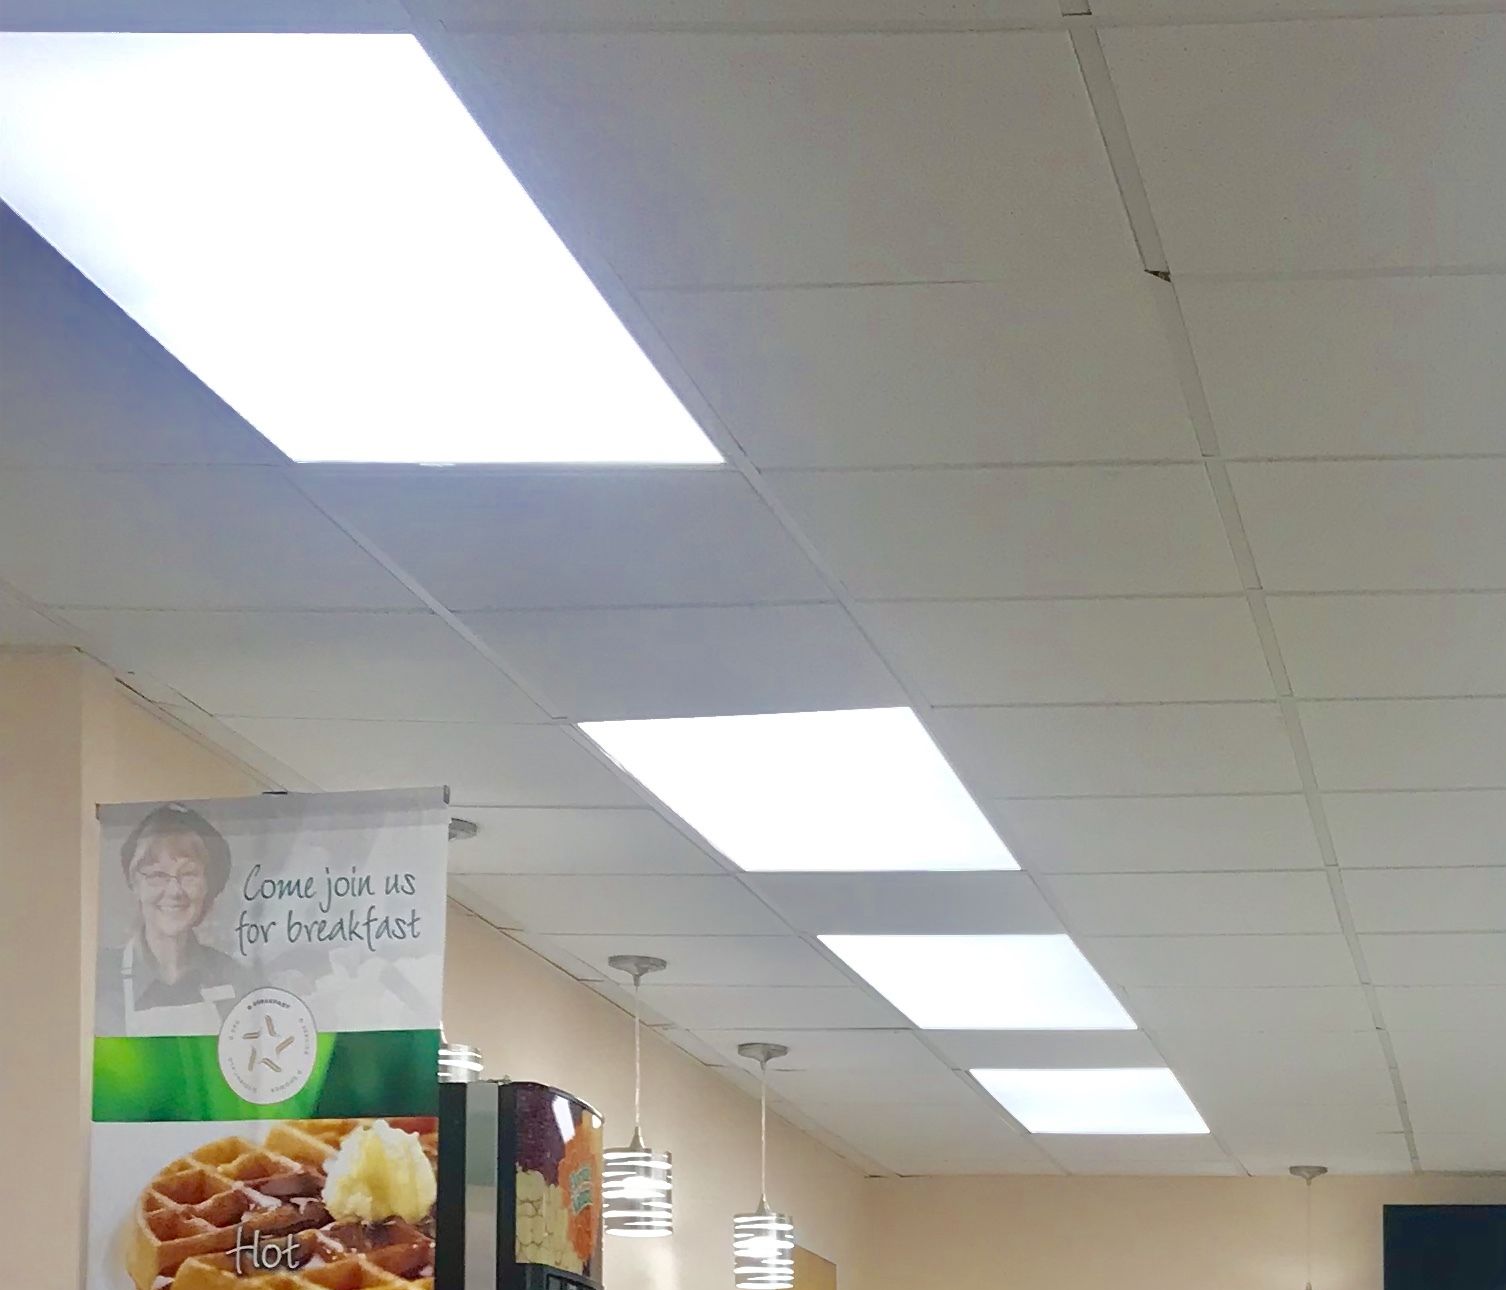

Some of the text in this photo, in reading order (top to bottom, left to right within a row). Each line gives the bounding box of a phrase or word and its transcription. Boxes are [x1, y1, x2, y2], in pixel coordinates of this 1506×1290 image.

[243, 864, 416, 913] Come join us
[235, 905, 421, 956] for breakfast
[226, 1226, 300, 1274] Hot
